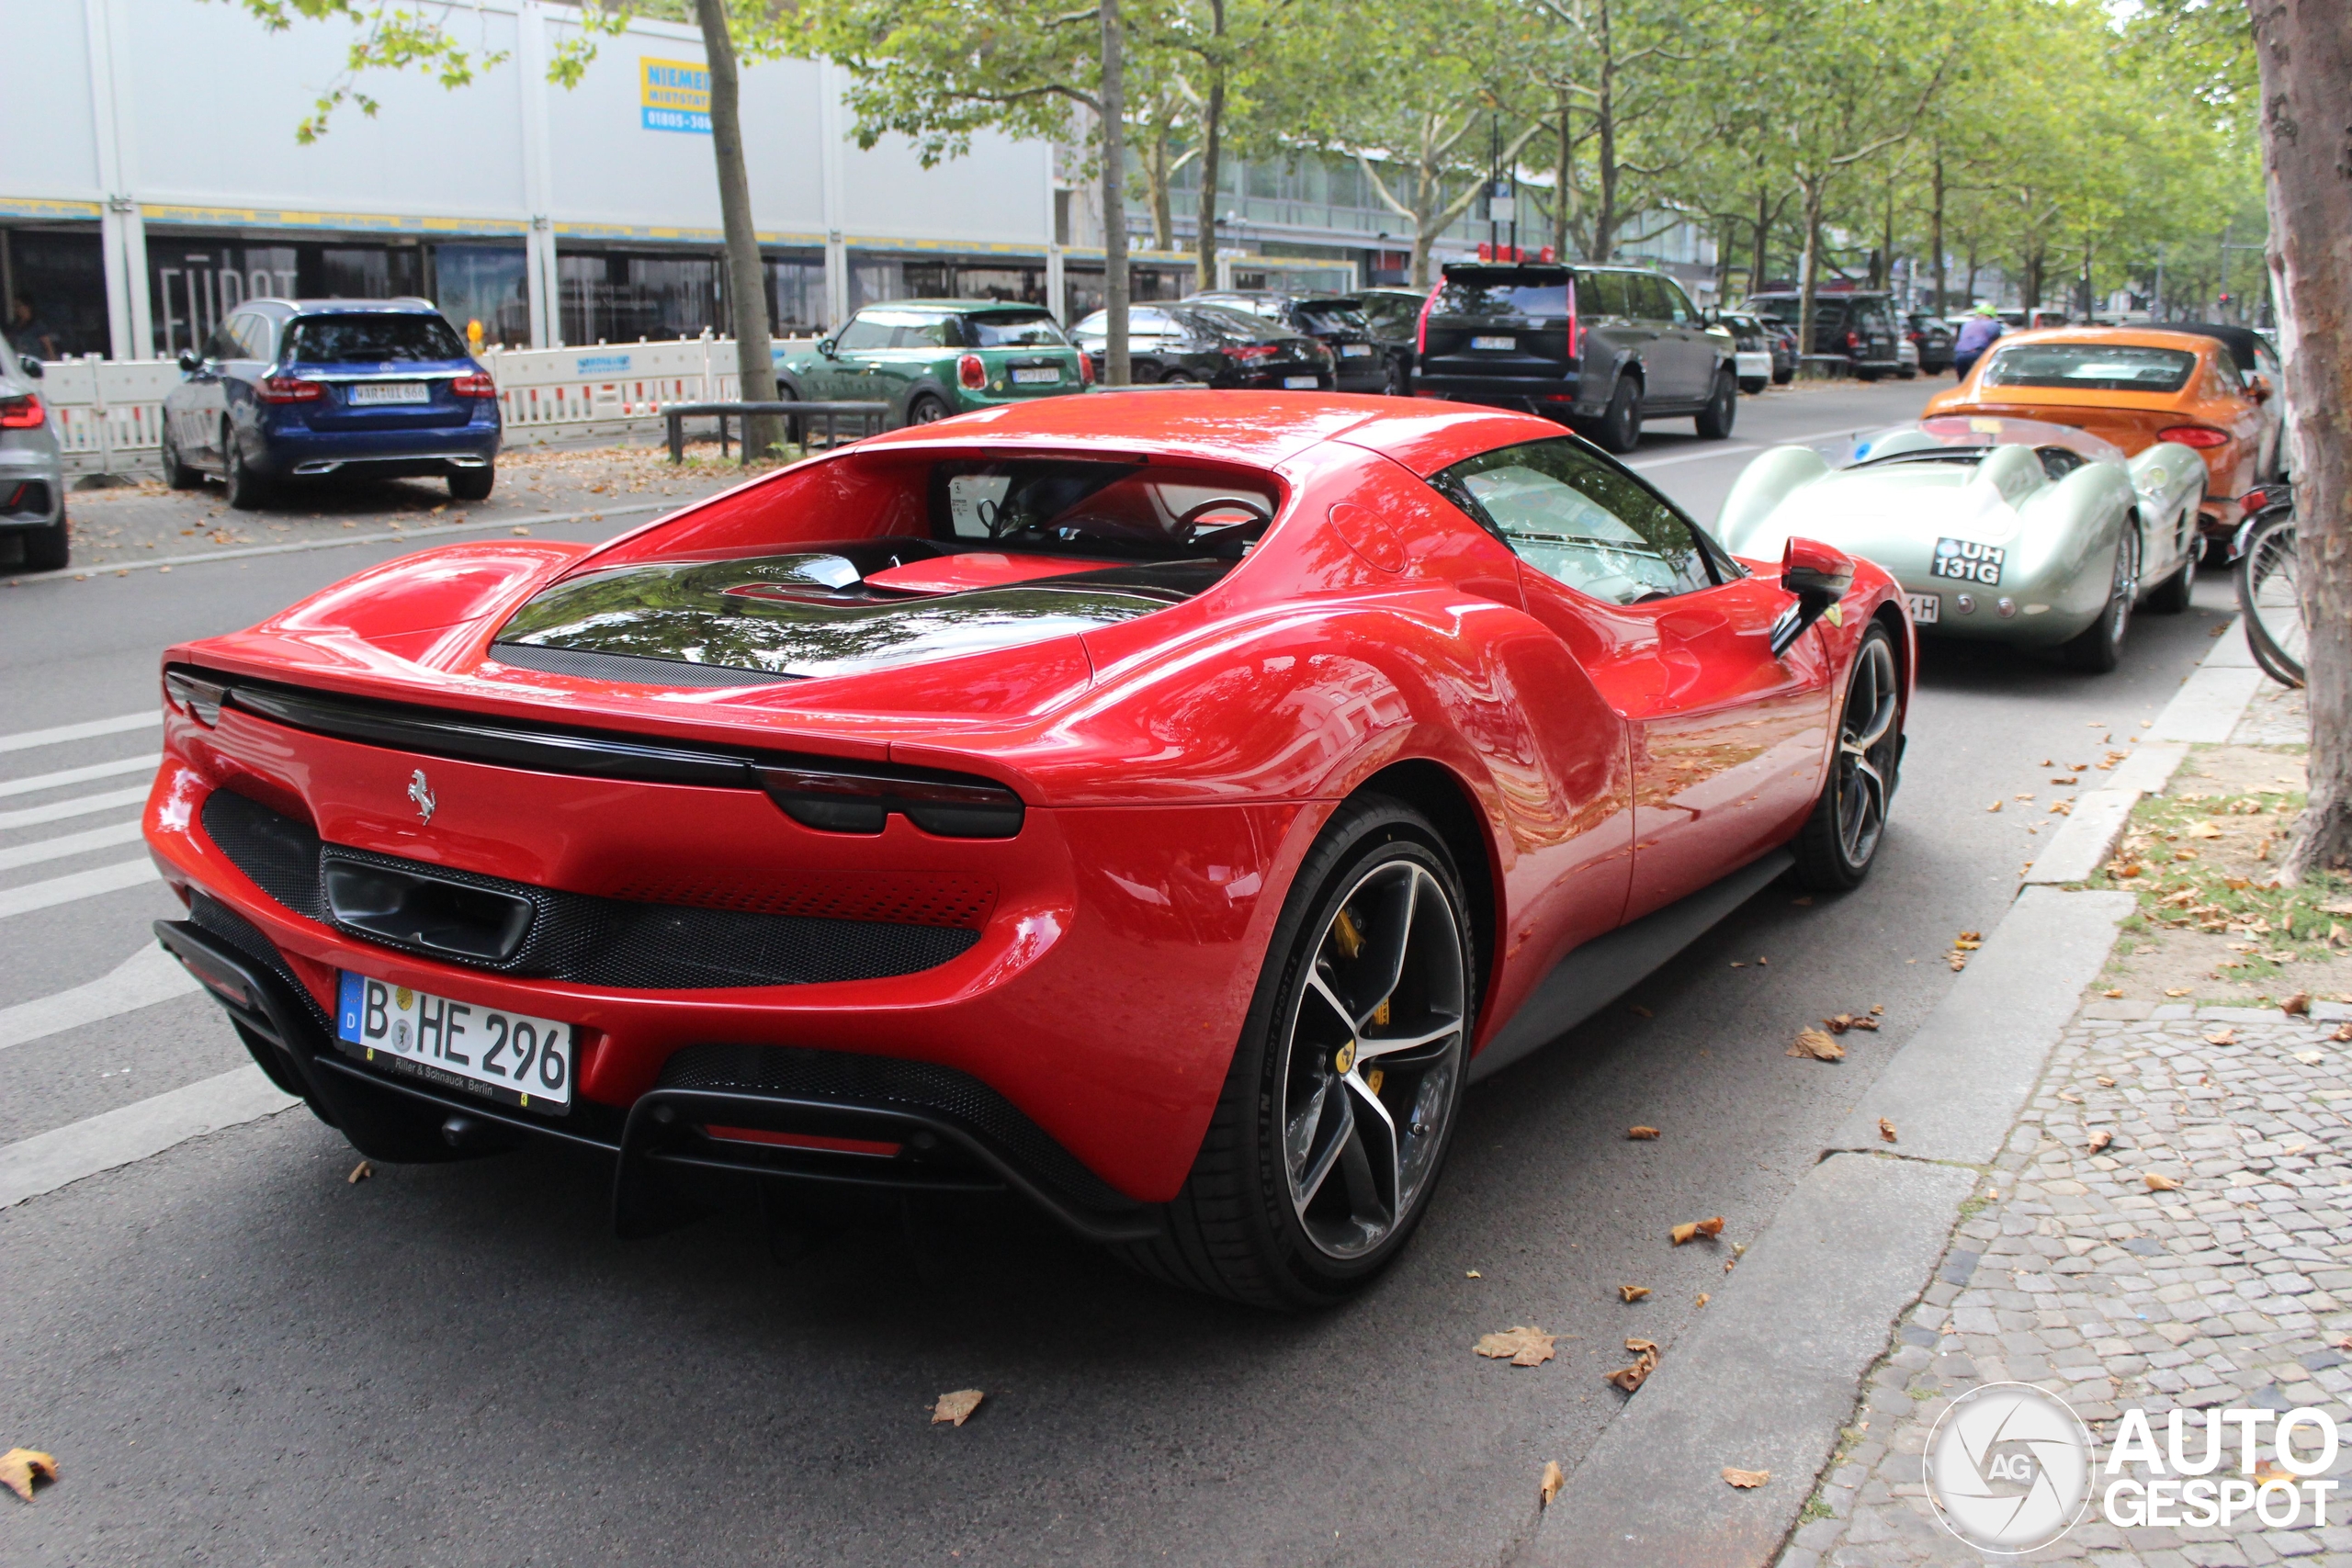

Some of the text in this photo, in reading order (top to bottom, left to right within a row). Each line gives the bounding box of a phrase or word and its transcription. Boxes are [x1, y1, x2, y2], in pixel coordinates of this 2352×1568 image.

[648, 66, 710, 92] NIEMEI
[649, 90, 707, 106] MIETSTAT
[1961, 542, 2004, 565] UH
[1936, 558, 2000, 584] 131G
[346, 1012, 356, 1030] D
[364, 981, 565, 1090] B HE 296
[395, 1057, 493, 1097] Riller & Schnauck Berlin
[1260, 1093, 1283, 1229] MICHELIN
